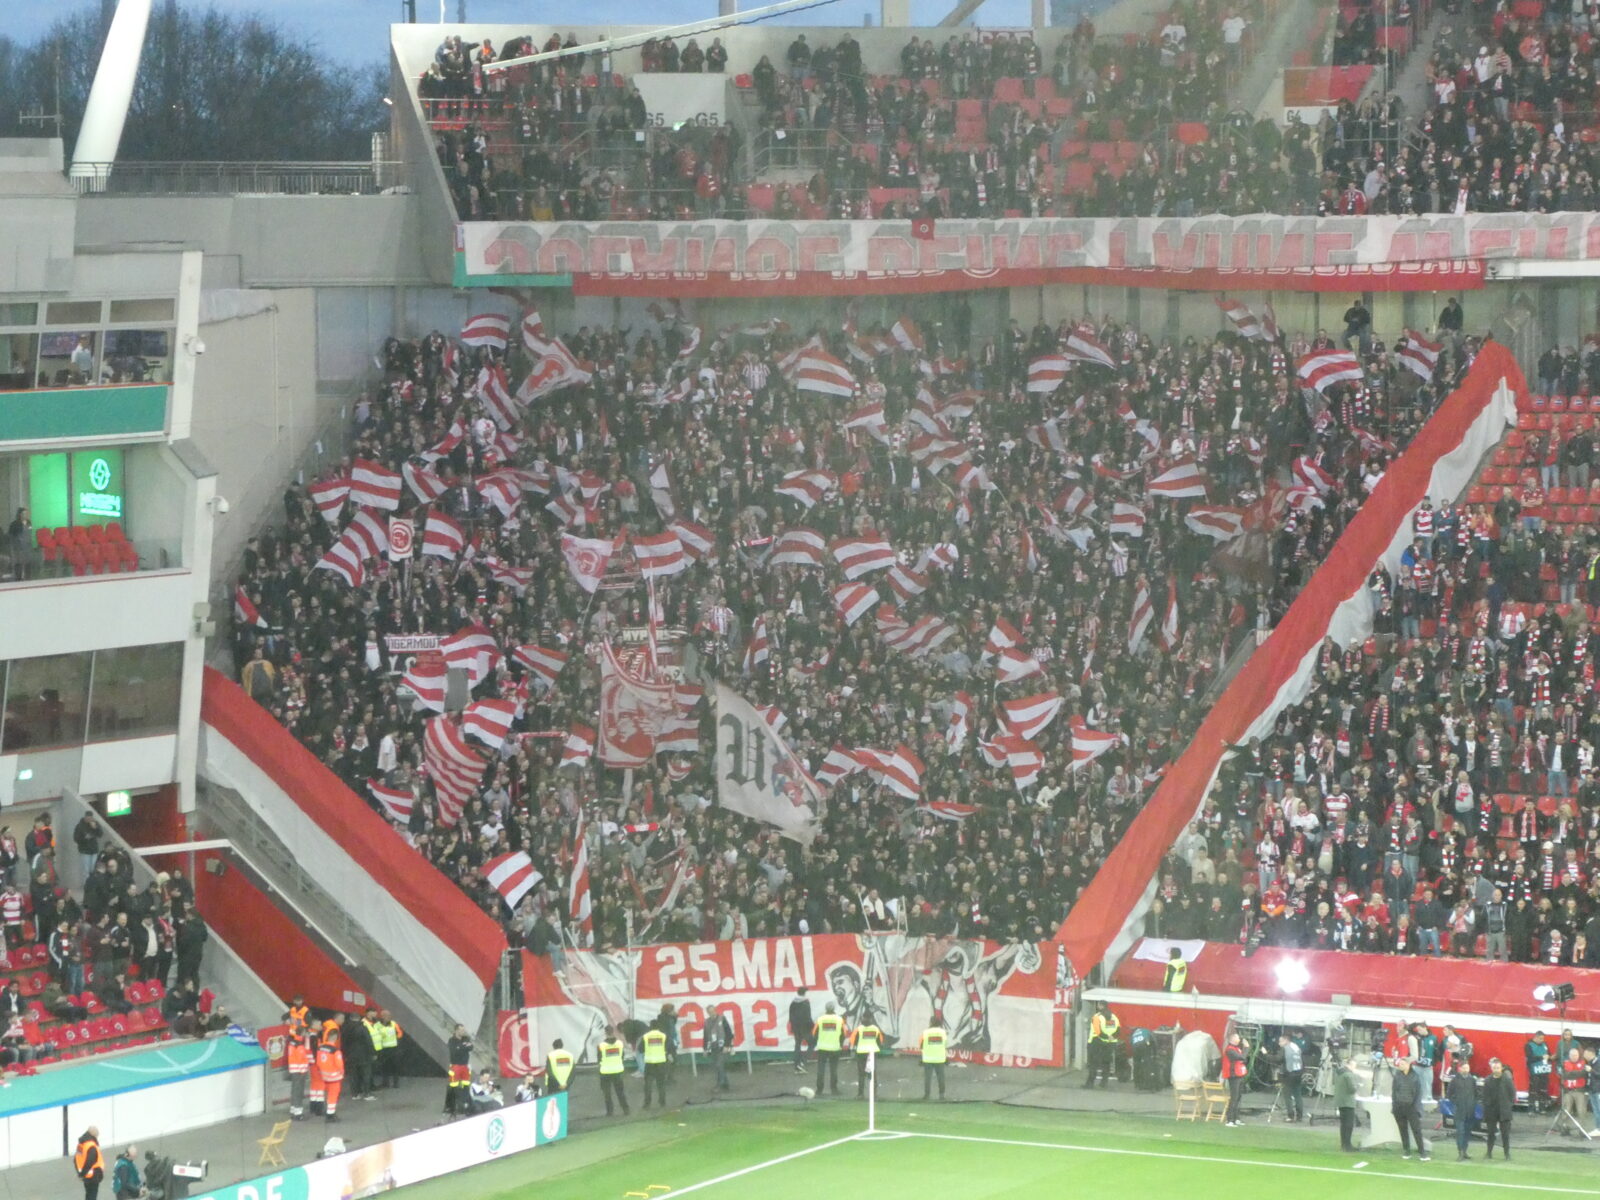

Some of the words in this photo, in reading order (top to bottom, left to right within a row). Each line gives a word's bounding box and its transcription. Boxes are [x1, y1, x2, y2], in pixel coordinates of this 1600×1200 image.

[695, 112, 719, 127] G5
[655, 936, 816, 995] 25.MAI
[677, 1000, 808, 1049] 202
